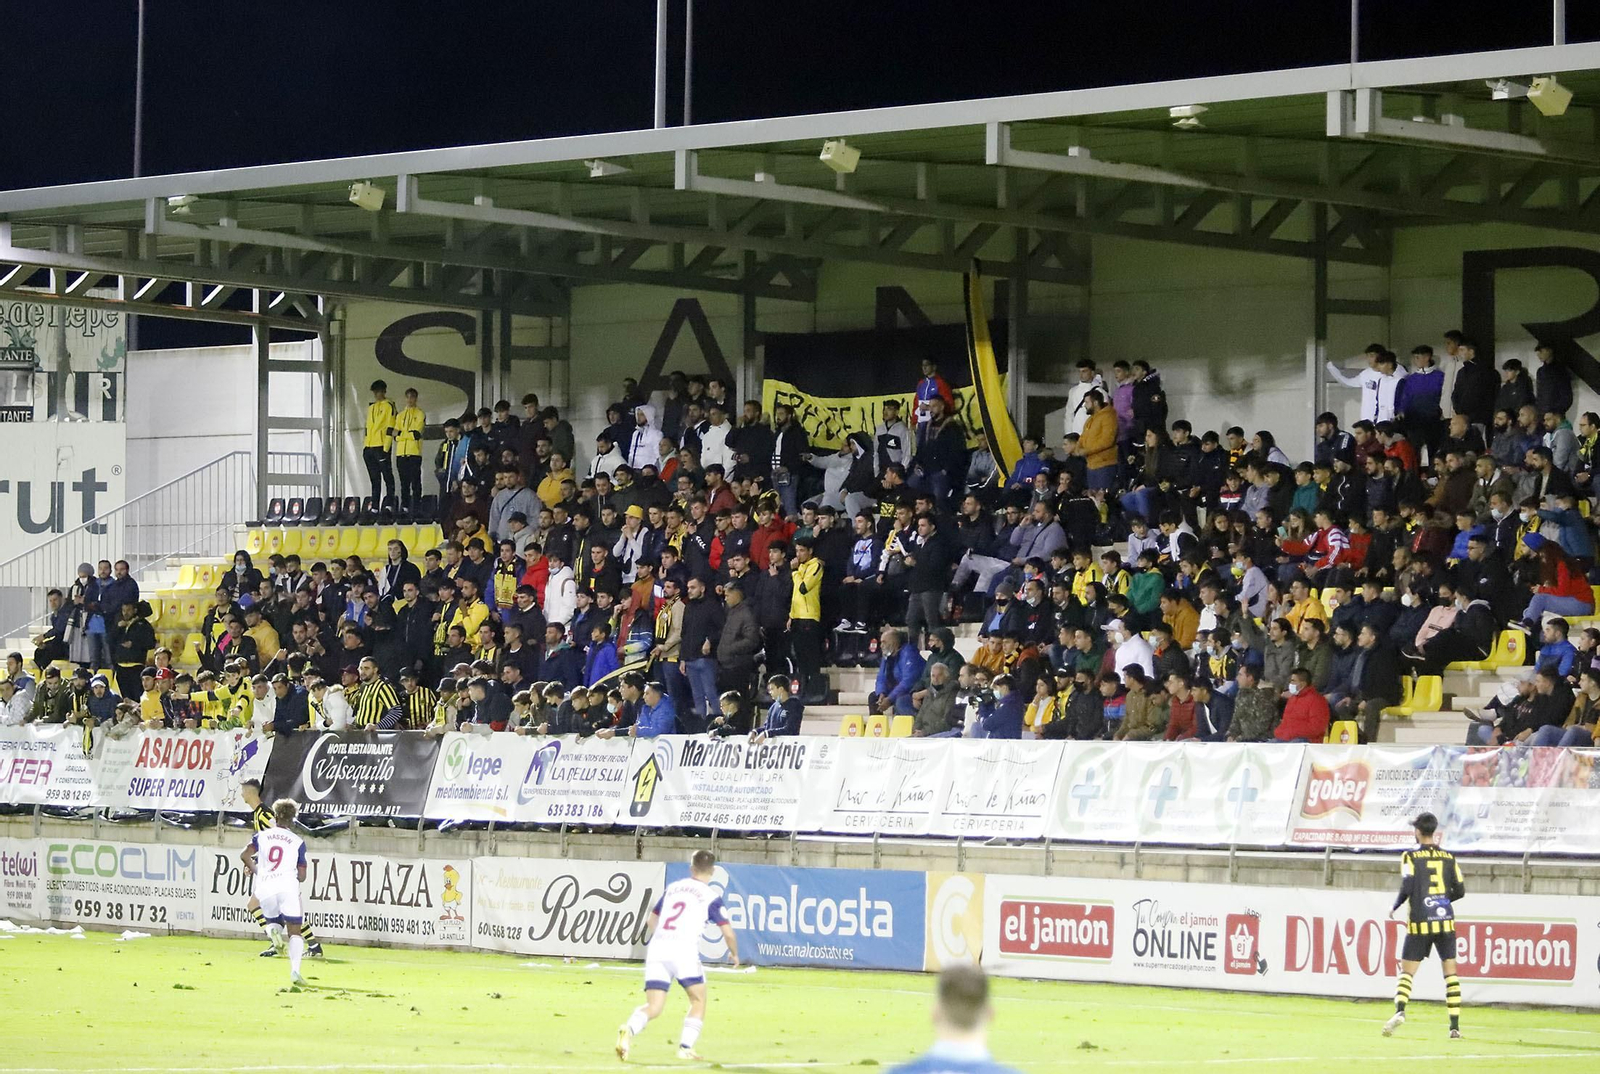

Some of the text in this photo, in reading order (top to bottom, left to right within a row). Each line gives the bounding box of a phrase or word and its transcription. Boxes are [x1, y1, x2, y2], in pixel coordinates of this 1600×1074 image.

[135, 737, 215, 770] ASADOR
[327, 743, 394, 755] HOTEL RESTAURANTE
[745, 740, 806, 770] Electric
[315, 756, 395, 788] Valsequillo
[551, 767, 565, 780] LA
[690, 770, 704, 780] THE
[45, 789, 58, 800] 959
[61, 790, 71, 800] 38
[72, 791, 80, 800] 12
[127, 777, 165, 797] SUPER
[167, 779, 206, 798] POLLO
[435, 783, 496, 800] medioambiental
[692, 784, 773, 795] INSTALADOR AUTORIZADO
[1308, 773, 1367, 806] gober
[547, 804, 604, 817] 639 383 186
[693, 811, 711, 823] 074
[713, 813, 729, 824] 465
[736, 814, 751, 825] 610
[752, 814, 768, 825] 405
[770, 815, 784, 826] 162
[267, 834, 293, 845] HASSAN
[47, 844, 196, 882] ECOCLIM
[268, 846, 284, 872] 9
[1413, 850, 1430, 858] FRAN
[1, 851, 37, 877] telwi
[310, 857, 343, 902] LA
[350, 860, 433, 908] PLAZA
[1427, 860, 1445, 894] 3
[154, 886, 174, 897] PLACAS
[175, 888, 196, 899] SOLARES
[75, 899, 167, 923] 959 38 17 32
[176, 911, 195, 920] VENTA
[663, 901, 686, 930] 2
[1180, 912, 1188, 925] el
[1189, 913, 1219, 928] jamón
[346, 914, 355, 930] AL
[358, 913, 389, 932] CARBÓN
[391, 918, 405, 933] 959
[407, 919, 419, 935] 481
[492, 924, 505, 939] 568
[507, 926, 522, 940] 228
[1005, 904, 1109, 950] el jamón
[439, 933, 446, 941] LA
[1133, 928, 1217, 960] ONLINE
[758, 942, 854, 961] www.canalcostatv.es
[1236, 940, 1246, 956] ej
[1456, 923, 1571, 974] el jamón
